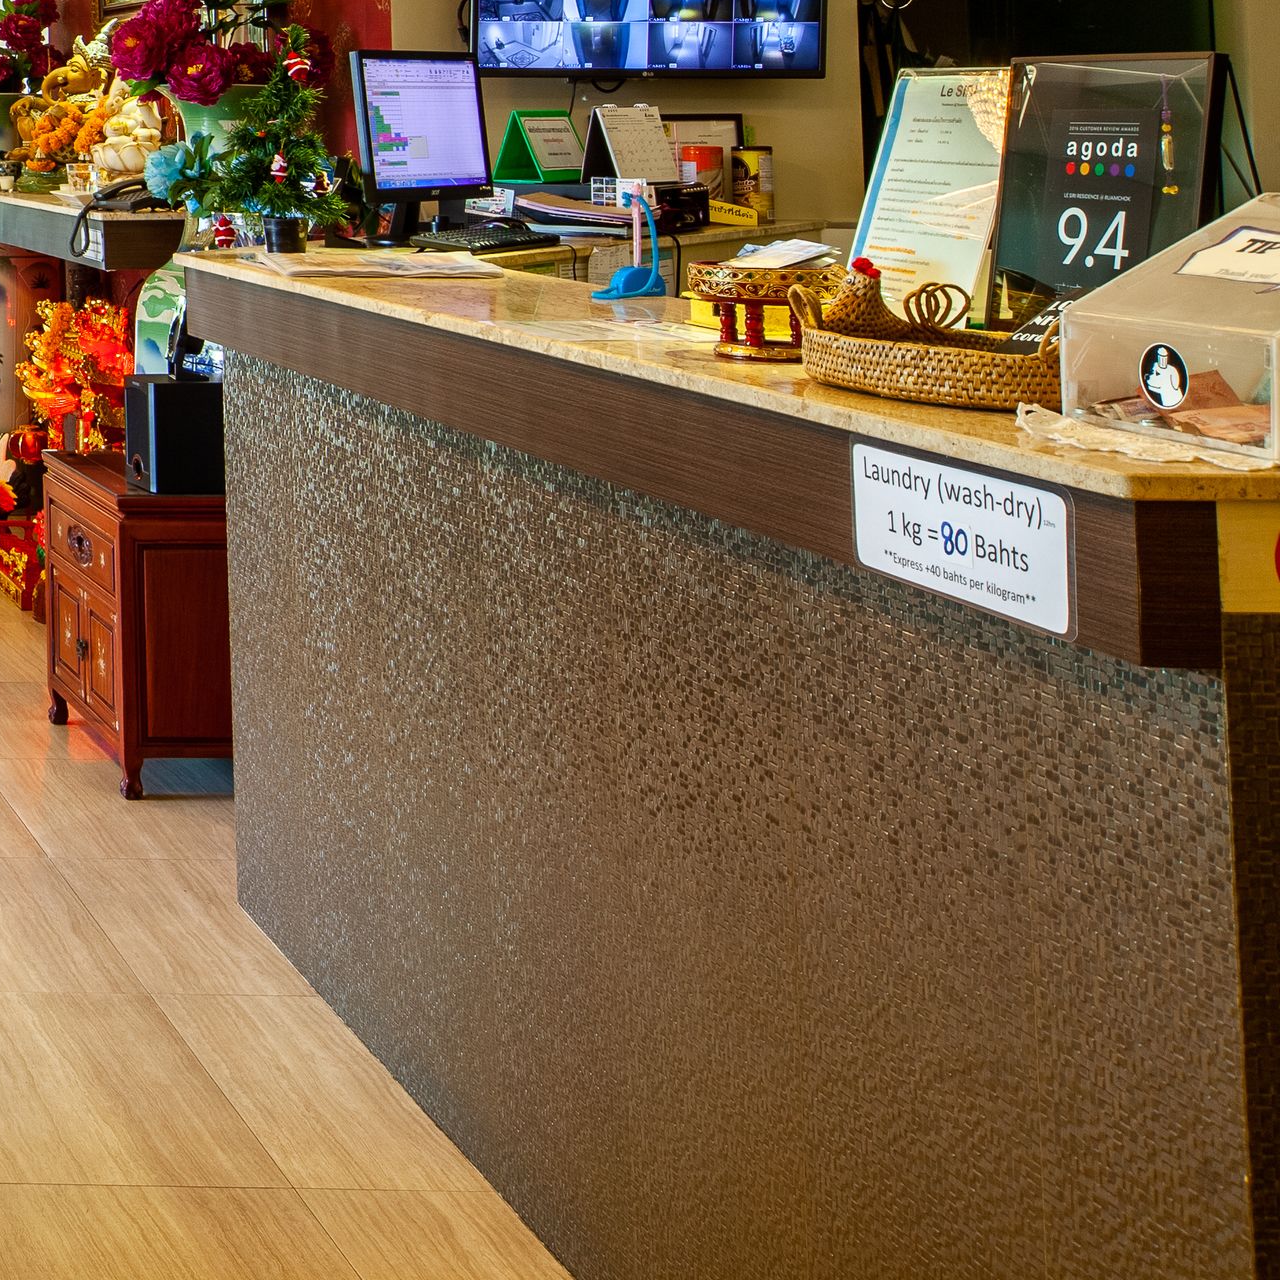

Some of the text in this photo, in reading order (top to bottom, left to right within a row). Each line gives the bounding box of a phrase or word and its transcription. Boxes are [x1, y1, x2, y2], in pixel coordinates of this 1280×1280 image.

[940, 85, 953, 97] Le
[1066, 137, 1138, 161] agoda
[1057, 206, 1129, 270] 9.4
[863, 456, 931, 500] Laundry
[937, 473, 1042, 530] (wash-dry)
[887, 510, 897, 534] 1
[902, 512, 922, 546] kg
[975, 533, 1029, 572] Bahts
[925, 564, 941, 578] +40
[943, 567, 968, 586] bahts
[969, 577, 984, 591] per
